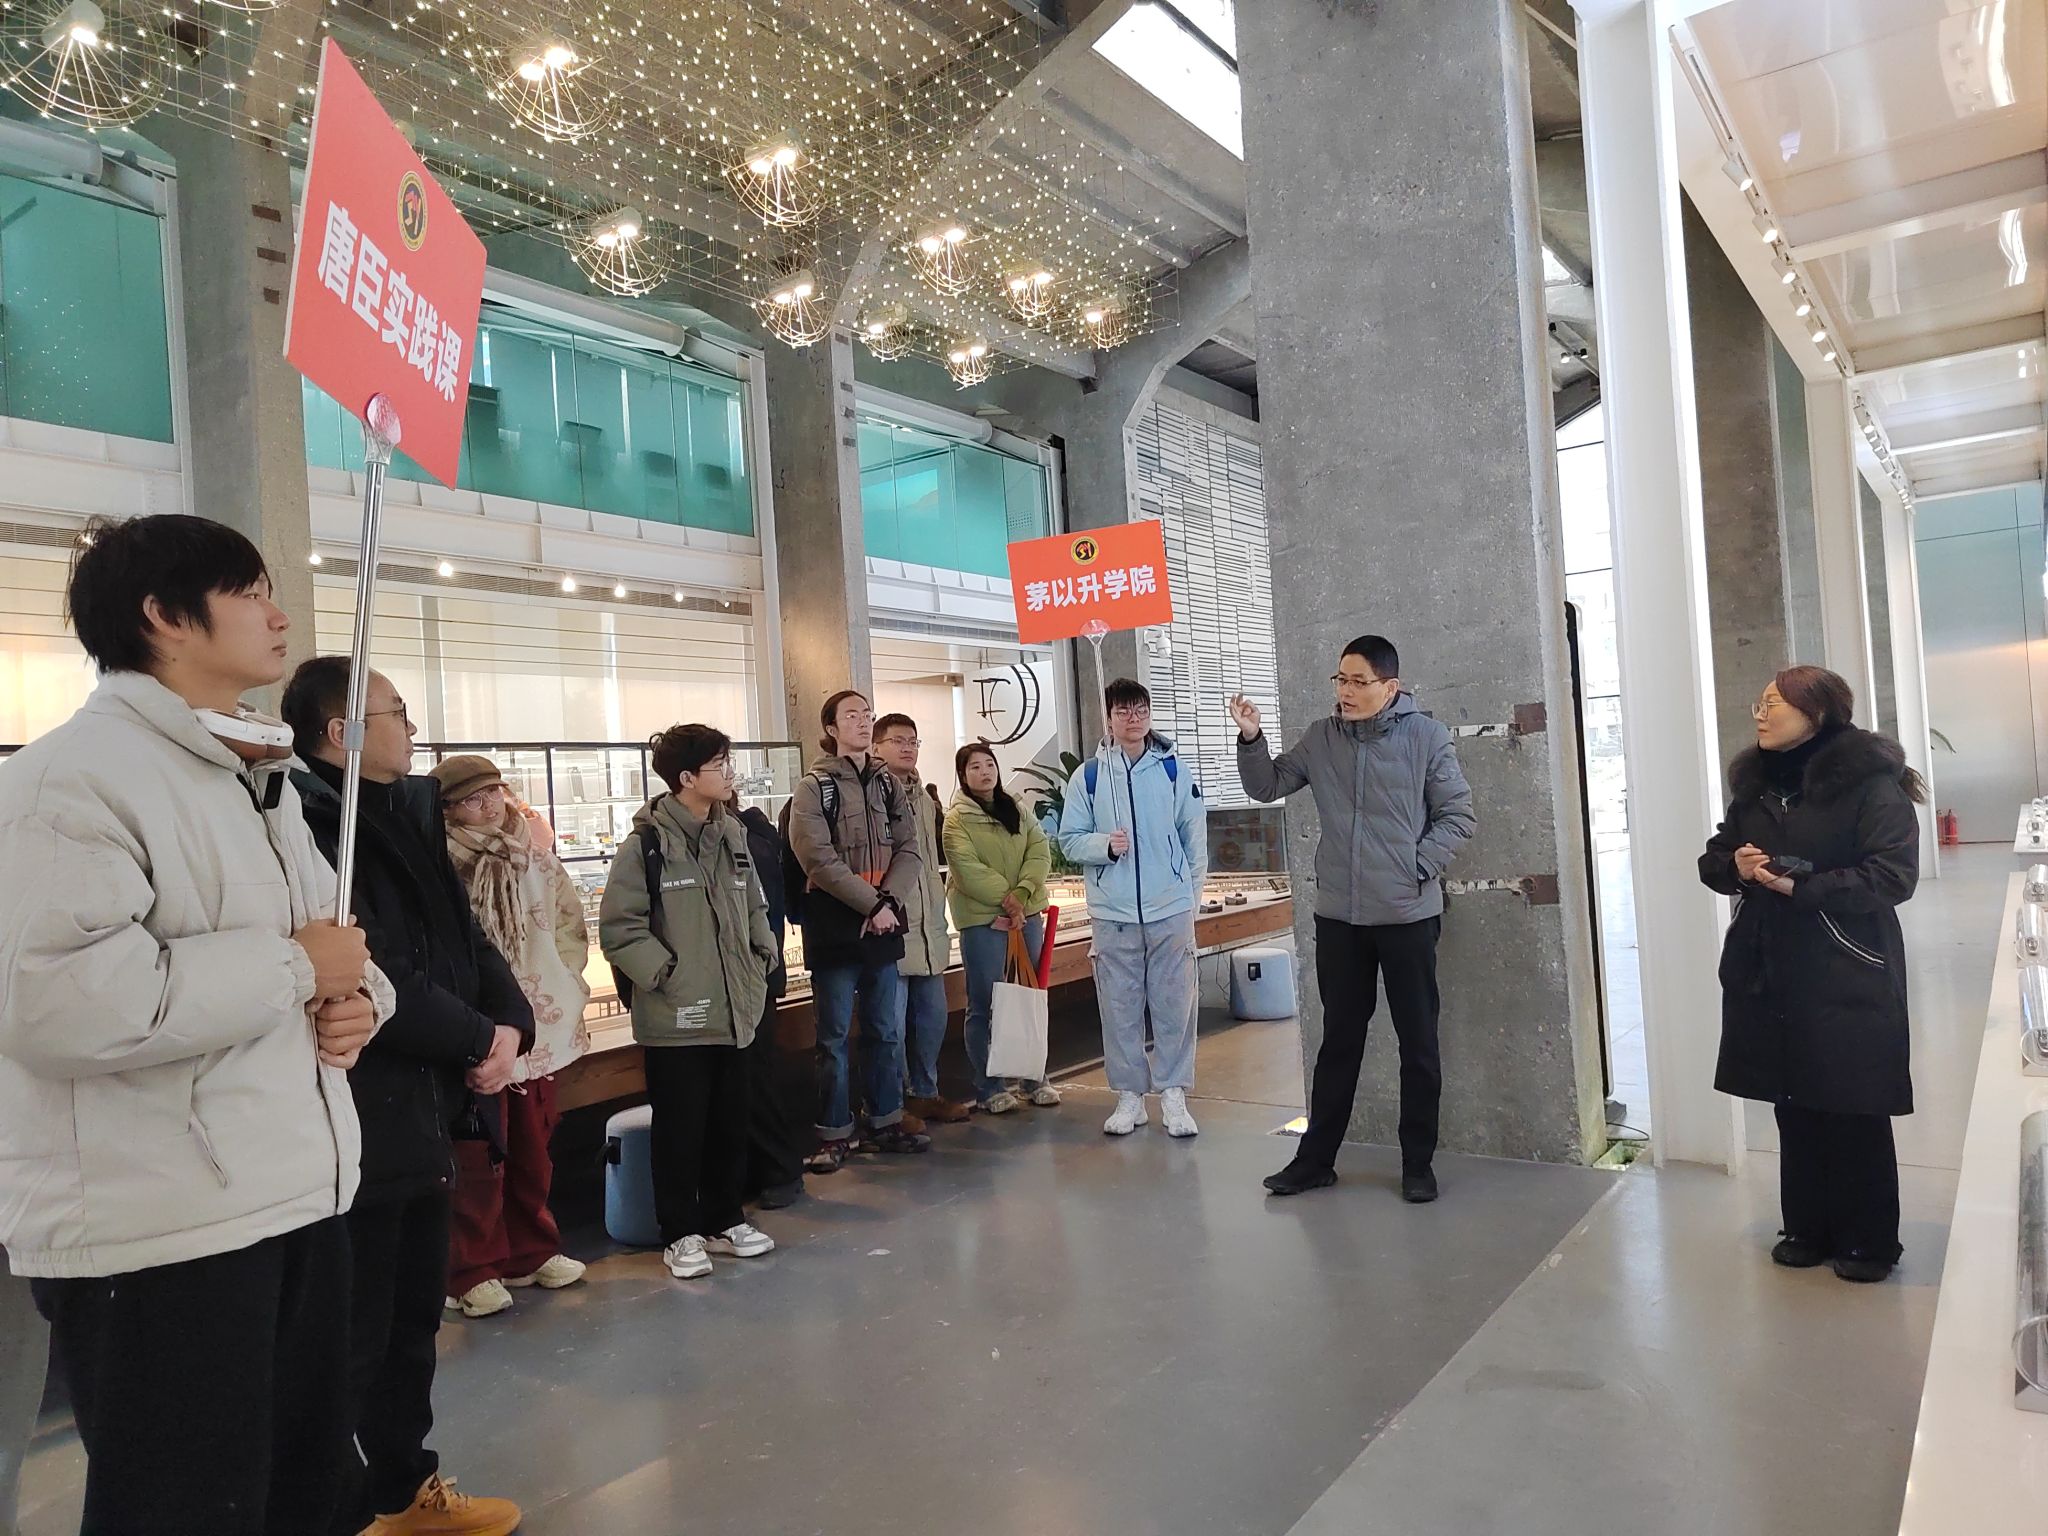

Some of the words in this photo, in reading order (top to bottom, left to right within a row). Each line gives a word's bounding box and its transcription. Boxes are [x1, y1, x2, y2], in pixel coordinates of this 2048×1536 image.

[318, 200, 462, 403] 唐臣实践课
[1024, 565, 1156, 612] 茅以升学院
